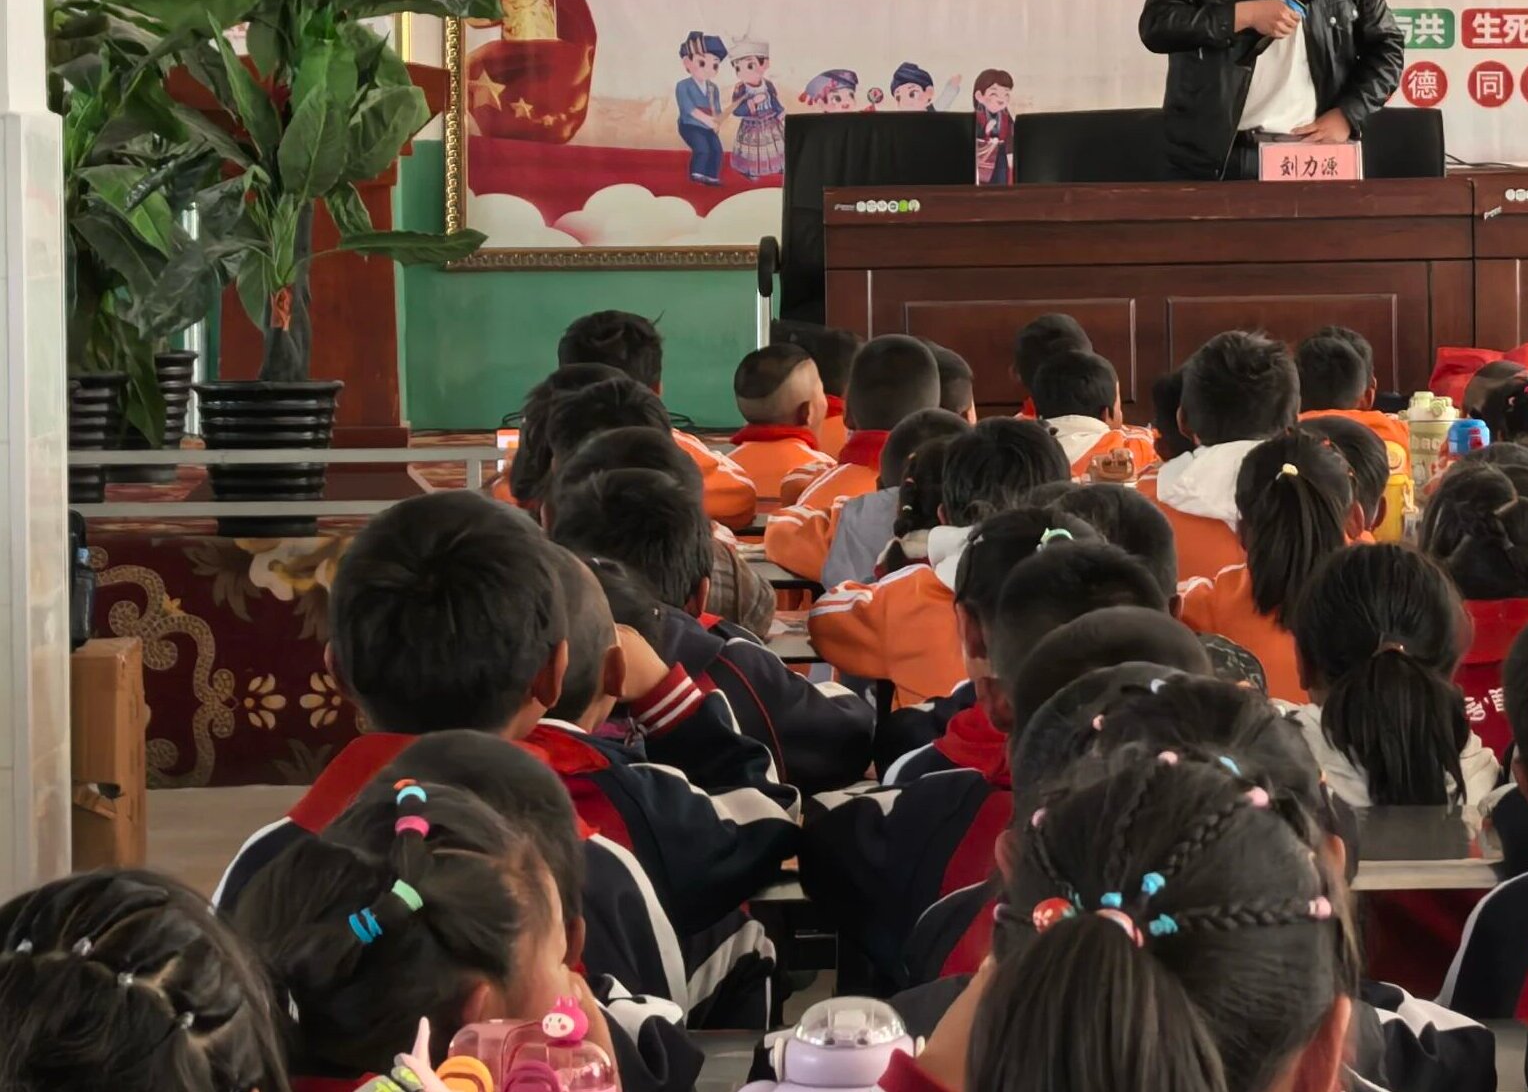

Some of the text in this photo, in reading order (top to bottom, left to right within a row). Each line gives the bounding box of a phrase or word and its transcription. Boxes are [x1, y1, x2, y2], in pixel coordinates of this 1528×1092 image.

[1407, 70, 1438, 101] 德
[1280, 155, 1339, 178] 刘力源
